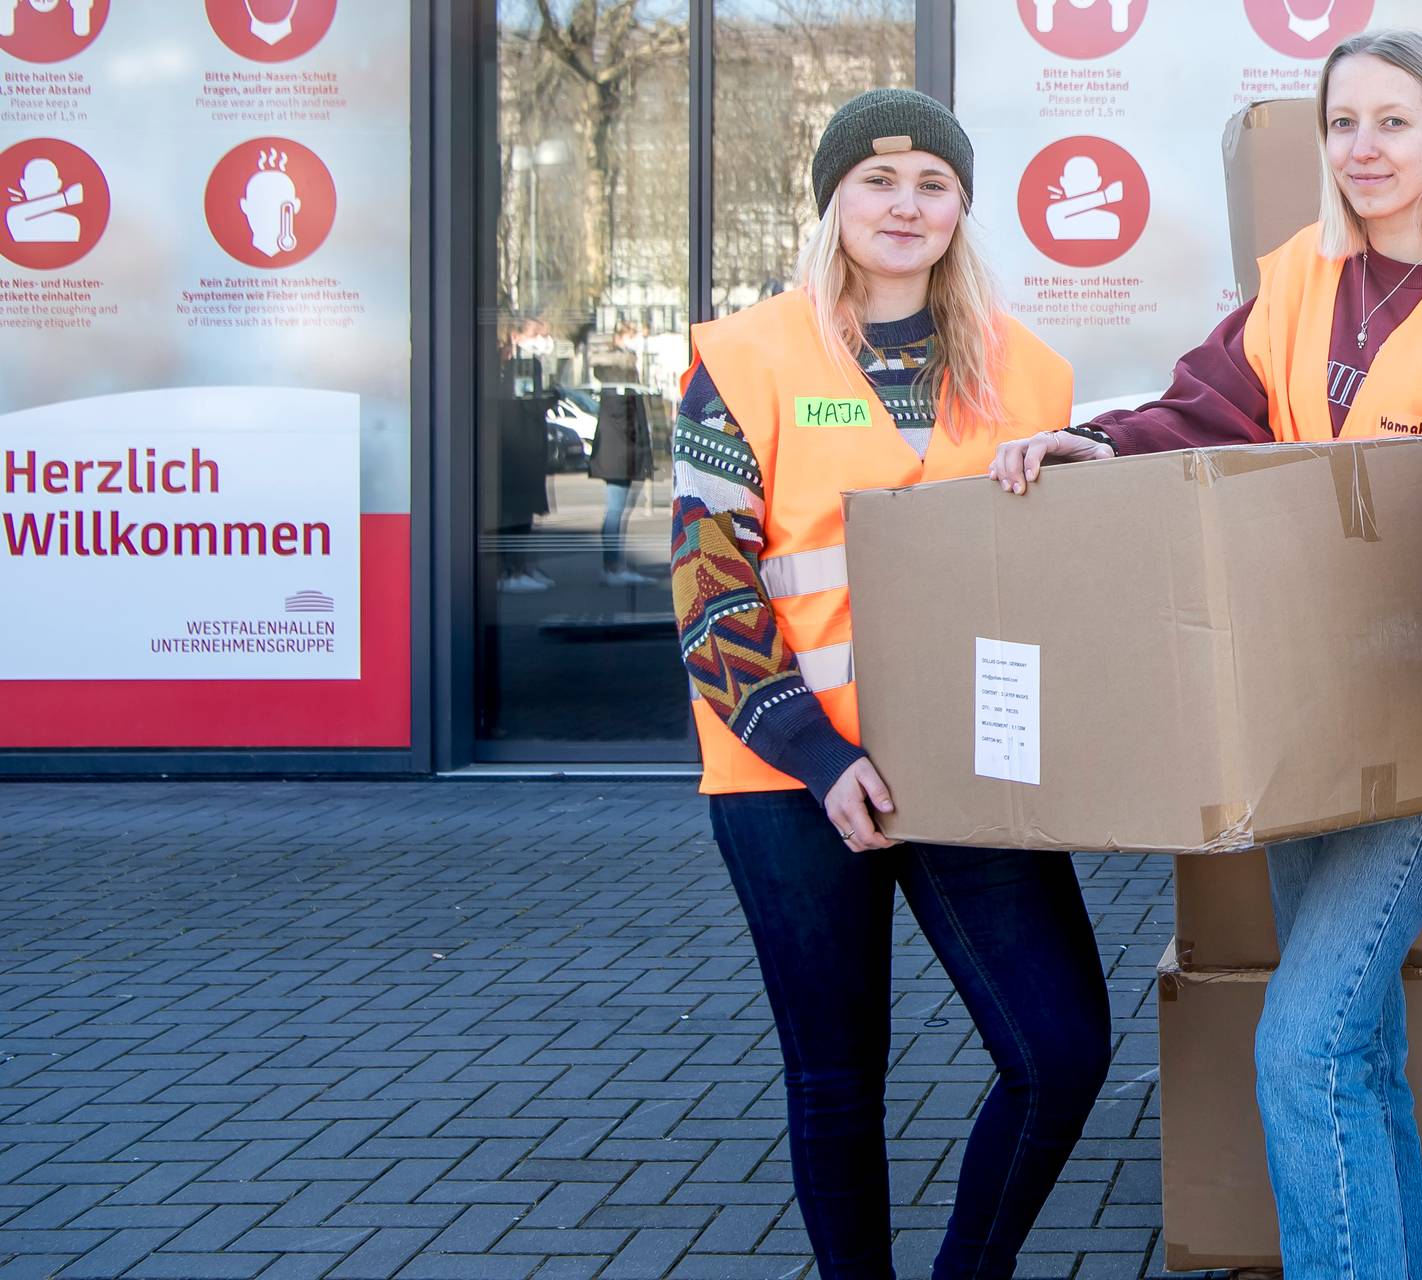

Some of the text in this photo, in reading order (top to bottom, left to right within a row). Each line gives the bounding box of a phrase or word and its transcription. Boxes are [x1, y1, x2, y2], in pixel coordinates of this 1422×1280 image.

[5, 72, 84, 82] Bitte halten Sie
[205, 72, 337, 82] Bitte Mund-Nasen-Schutz
[1043, 69, 1122, 78] Bitte halten Sie
[1243, 69, 1268, 78] Bitte
[15, 85, 46, 95] Meter
[48, 85, 92, 95] Abstand
[203, 84, 339, 97] tragen, außer am Sitzplatz
[1036, 82, 1129, 93] 1,5 Meter Abstand
[10, 98, 44, 108] Please
[45, 98, 70, 109] keep
[195, 98, 229, 107] Please
[266, 98, 300, 107] mouth
[302, 98, 321, 107] and
[322, 100, 347, 108] nose
[1048, 95, 1081, 104] Please
[1083, 95, 1108, 106] keep
[0, 111, 45, 121] distance
[46, 111, 57, 121] of
[212, 111, 330, 122] cover except at the seat
[1039, 108, 1082, 117] distance
[1084, 107, 1095, 117] of
[12, 278, 39, 288] Nies-
[41, 278, 60, 288] und
[63, 278, 104, 288] Husten-
[200, 278, 222, 287] Kein
[224, 278, 260, 287] Zutritt
[262, 278, 279, 287] mit
[1024, 277, 1144, 286] Bitte Nies- und Husten-
[42, 292, 91, 301] einhalten
[182, 291, 359, 303] Symptomen wie Fieber und Husten
[1037, 290, 1130, 299] etikette einhalten
[6, 305, 30, 314] note
[32, 304, 49, 314] the
[50, 304, 97, 317] coughing
[98, 304, 118, 314] and
[176, 304, 190, 313] No
[228, 304, 242, 313] for
[244, 305, 286, 316] persons
[288, 303, 310, 313] with
[312, 304, 366, 316] symptoms
[1010, 303, 1158, 315] Please note the coughing and
[44, 318, 91, 329] etiquette
[187, 317, 352, 329] of illness such as fever and cough
[1037, 316, 1130, 327] sneezing etiquette
[807, 402, 866, 426] MAJA
[5, 448, 219, 493] Herzlich
[2, 511, 331, 556] Willkommen
[187, 621, 335, 635] WESTFALENHALLEN
[151, 639, 335, 653] UNTERNEHMENSGRUPPE
